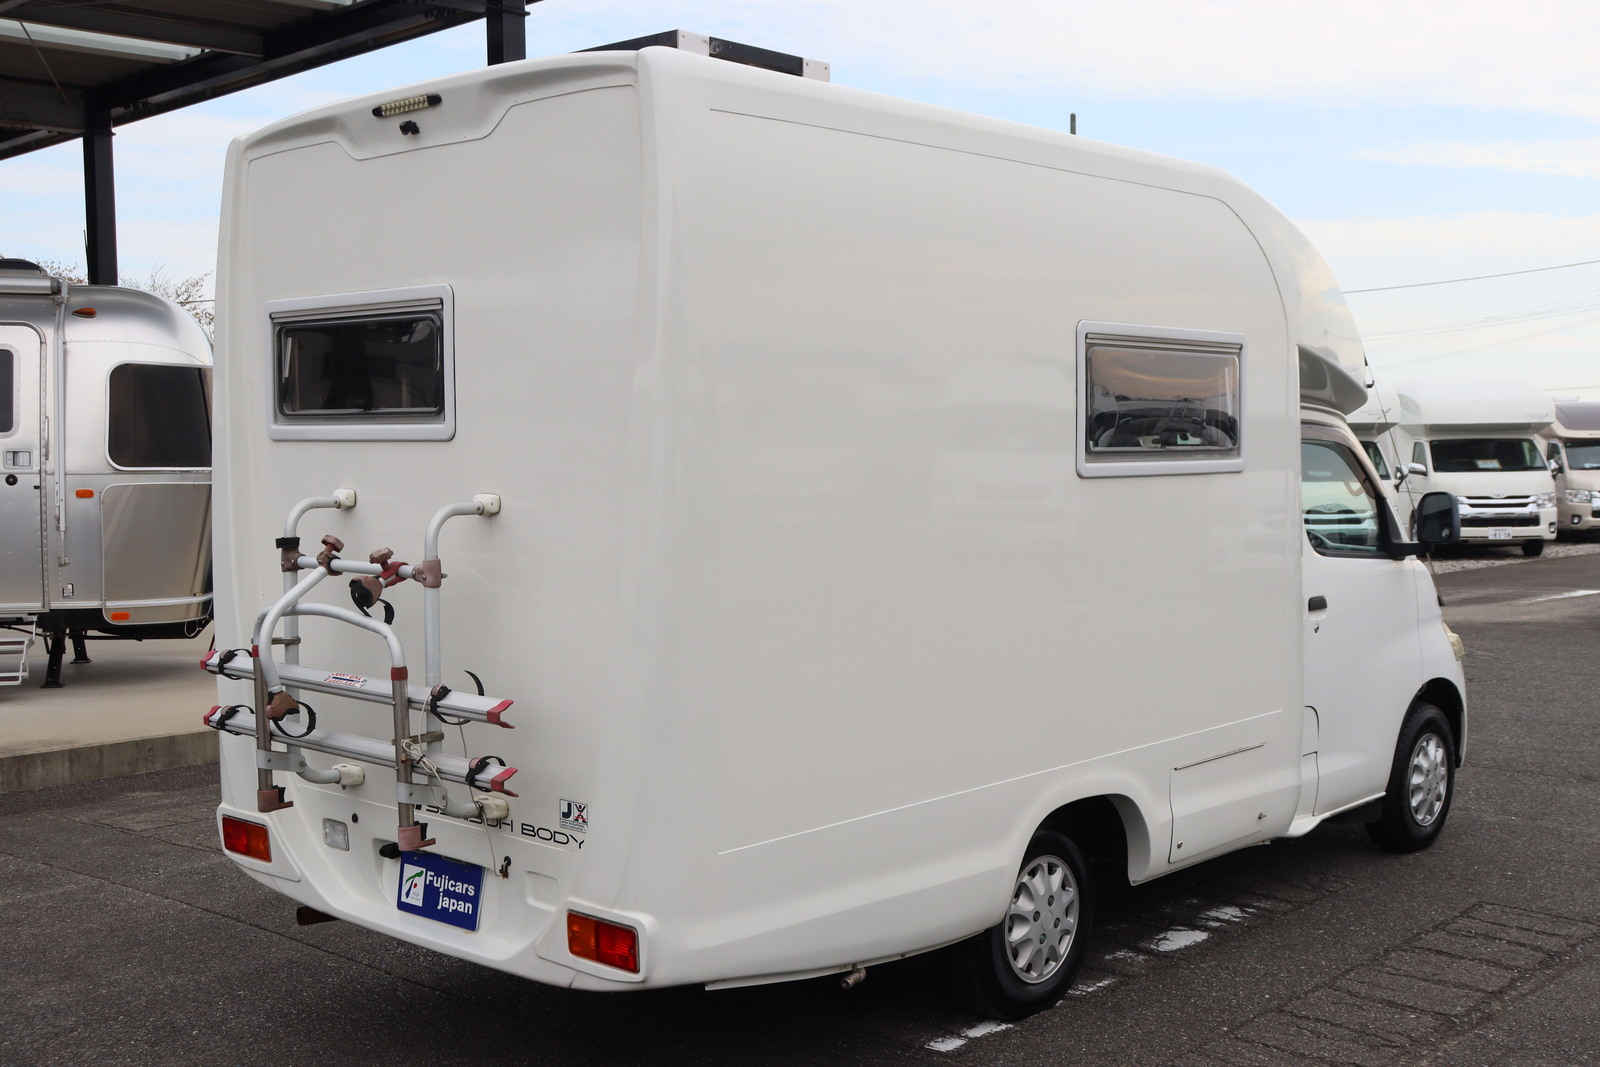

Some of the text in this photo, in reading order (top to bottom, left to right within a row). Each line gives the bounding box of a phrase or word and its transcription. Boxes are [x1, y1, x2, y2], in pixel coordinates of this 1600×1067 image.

[521, 822, 585, 849] BODY
[426, 871, 475, 897] Fujicars
[437, 892, 473, 915] japan
